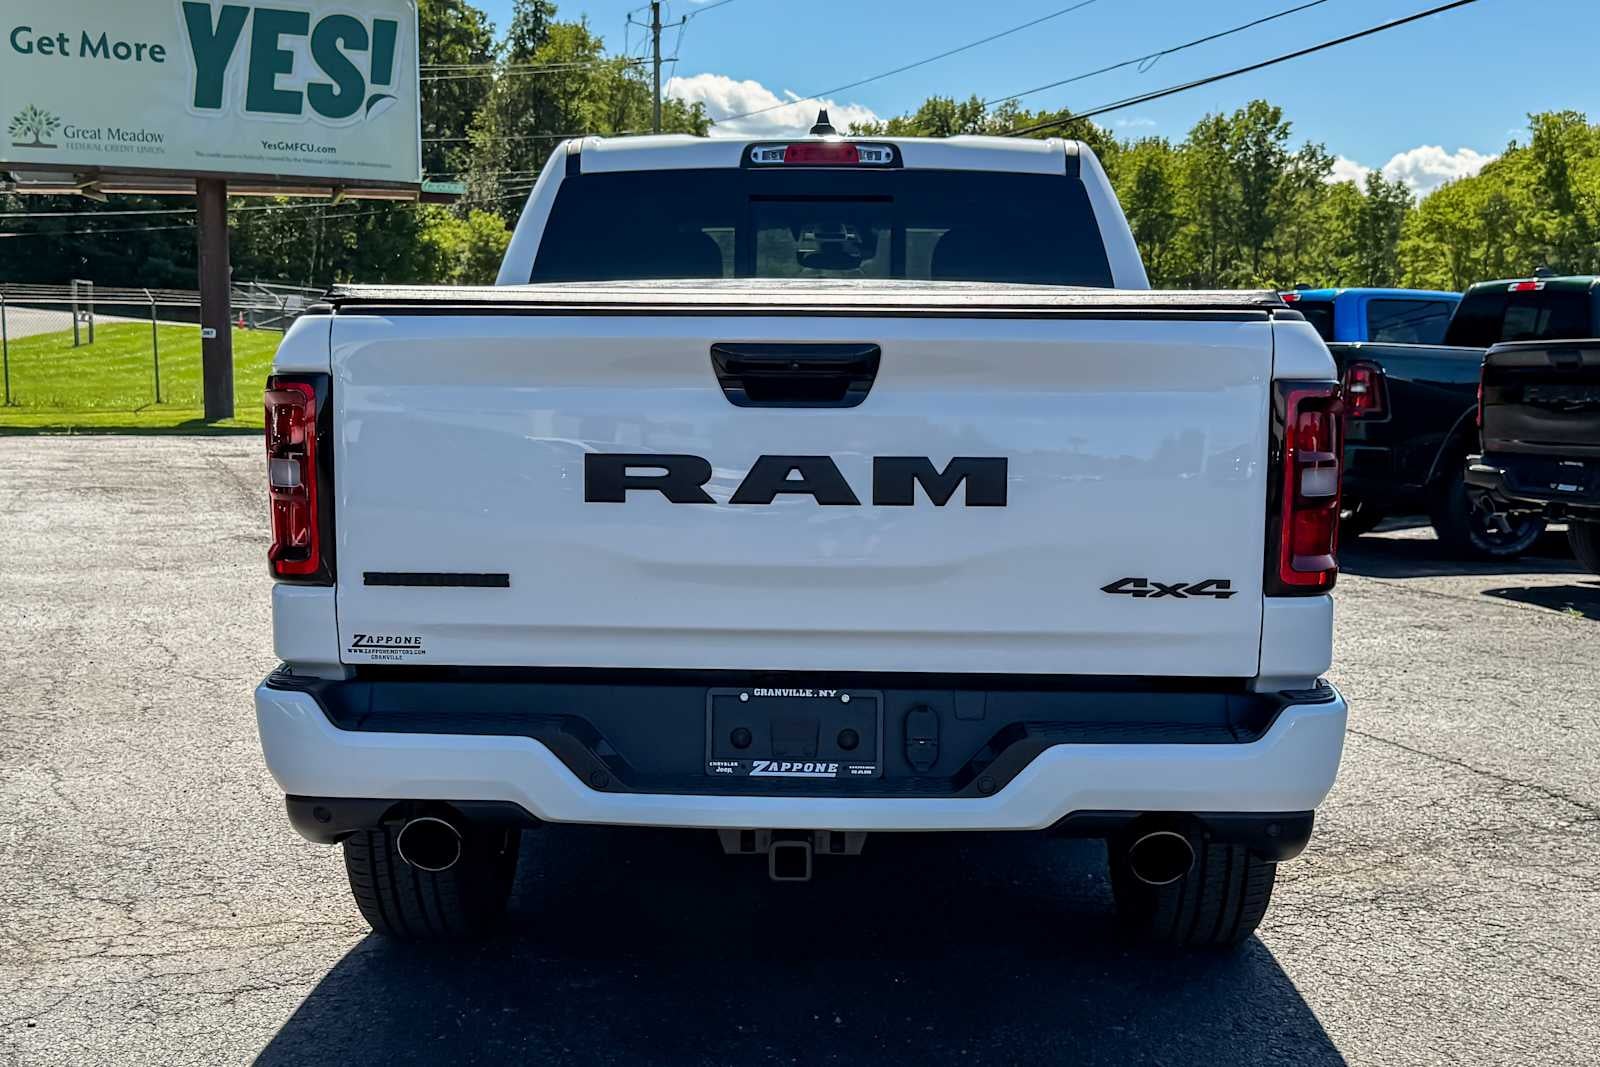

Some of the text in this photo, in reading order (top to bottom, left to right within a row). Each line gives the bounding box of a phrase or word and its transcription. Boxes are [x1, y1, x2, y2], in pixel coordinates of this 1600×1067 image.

[10, 26, 167, 64] Get More
[182, 1, 399, 120] YES!
[63, 124, 165, 143] Great Meadow
[66, 142, 103, 152] FEDERAL
[104, 143, 134, 153] CREDIT
[261, 140, 337, 154] YesGMFCU.com
[584, 453, 1008, 507] RAM
[1100, 577, 1239, 599] 4x4
[351, 634, 422, 649] ZAPPONE
[715, 766, 734, 774] Jeep
[750, 760, 839, 777] ZAPPONE
